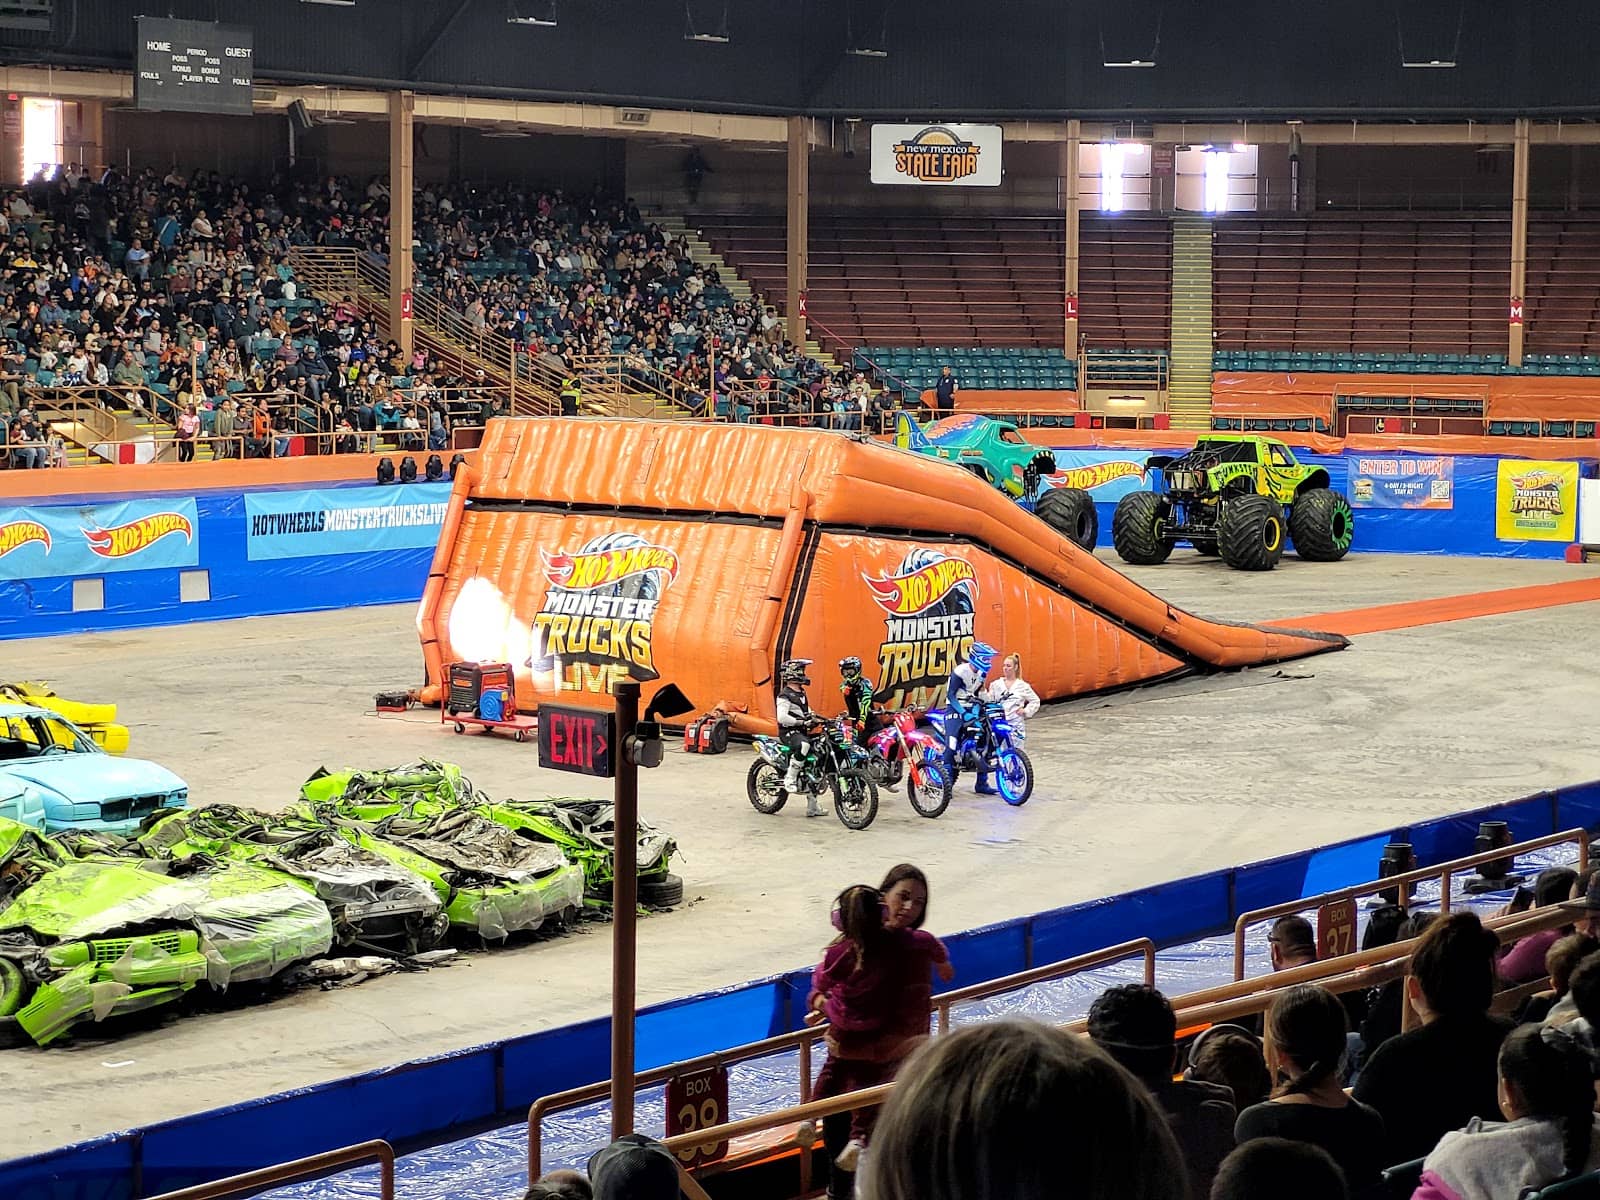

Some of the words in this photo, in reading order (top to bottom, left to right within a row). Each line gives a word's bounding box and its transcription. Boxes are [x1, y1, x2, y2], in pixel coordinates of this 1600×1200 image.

[147, 41, 171, 52] HOME
[186, 48, 207, 56] PERIOD
[225, 47, 252, 58] GUEST
[172, 55, 188, 63] POSS
[205, 57, 220, 65] POSS
[172, 65, 191, 73] BONUS
[201, 67, 220, 75] BONUS
[141, 71, 159, 79] FOULS
[182, 75, 203, 83] PLAYER
[205, 76, 220, 84] FOUL
[233, 78, 250, 86] FOULS
[907, 145, 929, 154] new
[930, 145, 967, 154] mexico
[896, 153, 939, 177] STATE
[942, 153, 977, 178] FAIR
[403, 299, 410, 312] J
[800, 299, 806, 311] K
[1067, 302, 1076, 313] L
[1511, 306, 1522, 318] M
[1360, 459, 1398, 475] ENTER
[1400, 460, 1416, 475] TO
[1417, 459, 1441, 475] WIN
[1516, 489, 1558, 497] MONSTER
[1512, 497, 1562, 513] TRUCKS
[1522, 510, 1552, 519] LIVE
[543, 591, 658, 621] MONSTER
[886, 613, 975, 641] MONSTER
[534, 614, 655, 672] TRUCKS
[550, 713, 595, 768] EXIT
[1331, 907, 1347, 922] BOX
[686, 1077, 711, 1096] BOX
